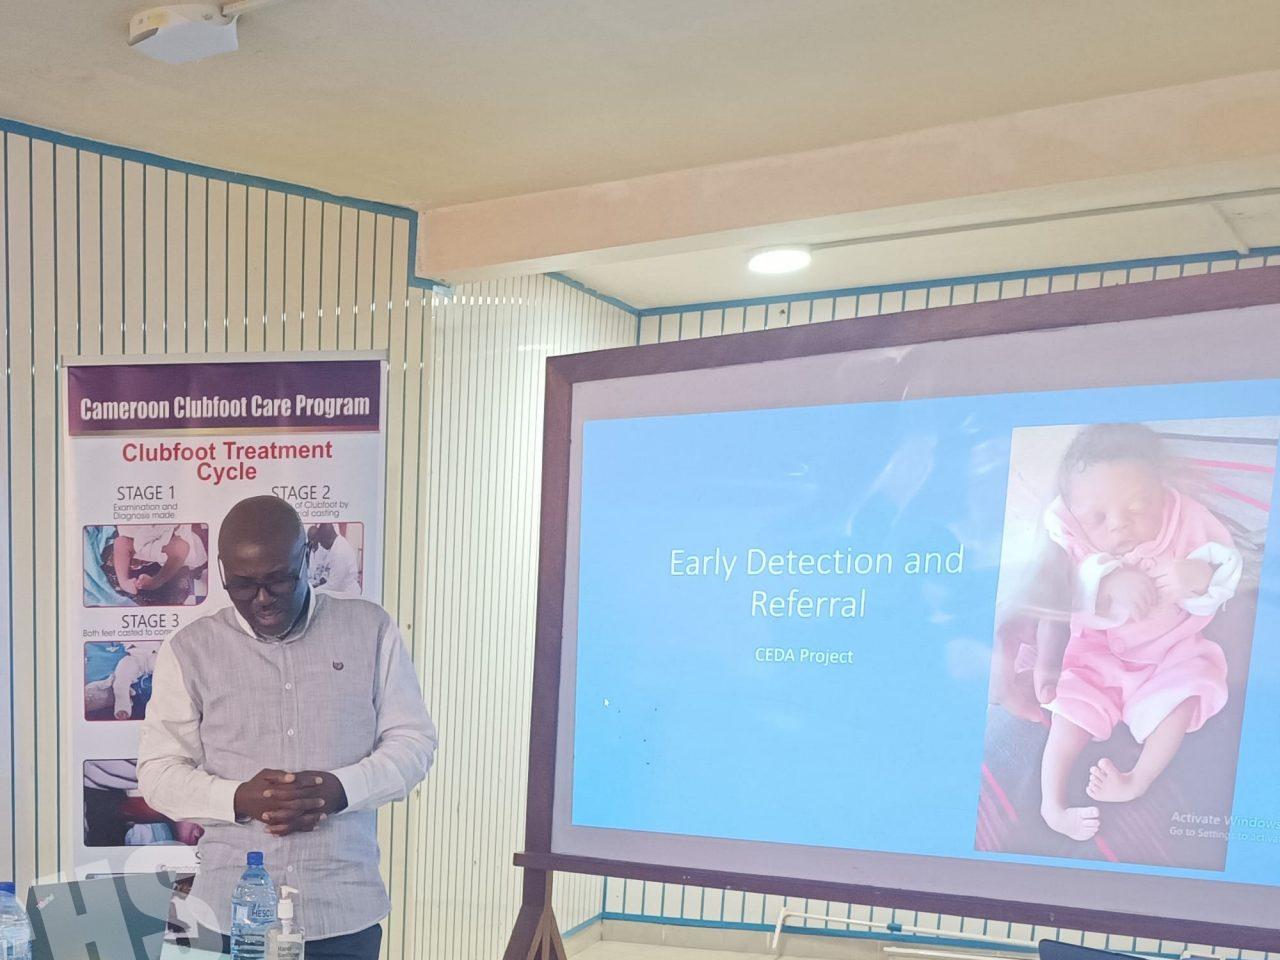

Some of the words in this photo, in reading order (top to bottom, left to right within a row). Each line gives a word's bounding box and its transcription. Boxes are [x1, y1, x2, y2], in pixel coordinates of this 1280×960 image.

[80, 398, 169, 420] Cameroon
[174, 396, 248, 418] Clubfoot
[251, 395, 291, 417] Care
[295, 395, 370, 419] Program
[123, 442, 216, 462] Clubfoot
[223, 440, 333, 460] Treatment
[196, 461, 257, 485] Cycle
[117, 485, 163, 500] STAGE
[168, 485, 175, 499] 1
[271, 485, 317, 500] STAGE
[322, 485, 331, 499] 2
[113, 503, 159, 511] Examination
[161, 503, 178, 511] and
[304, 501, 337, 509] Clubfoot
[339, 501, 349, 510] by
[113, 512, 149, 521] Diagnosis
[152, 511, 175, 519] made
[670, 547, 737, 581] Early
[747, 547, 892, 576] Detection
[904, 544, 964, 574] and
[751, 589, 867, 618] Referral
[122, 614, 166, 629] STAGE
[172, 614, 179, 628] 3
[83, 629, 100, 637] Both
[755, 647, 795, 663] CEDA
[800, 648, 854, 666] Project
[1171, 811, 1221, 825] Activate
[1169, 826, 1183, 836] Go
[1185, 827, 1196, 837] to
